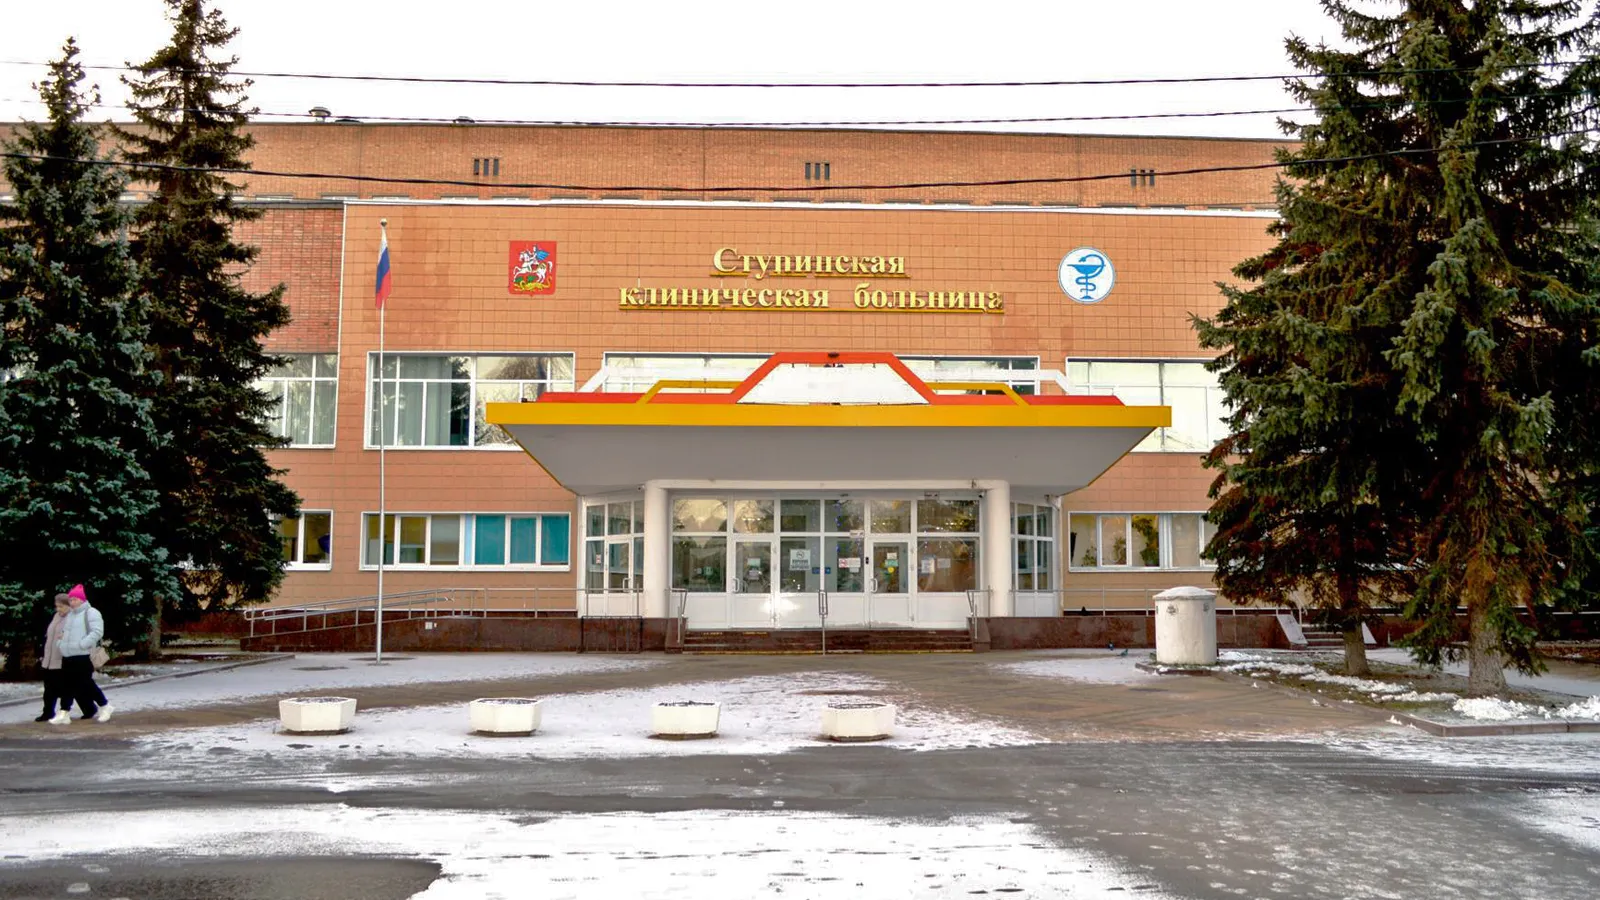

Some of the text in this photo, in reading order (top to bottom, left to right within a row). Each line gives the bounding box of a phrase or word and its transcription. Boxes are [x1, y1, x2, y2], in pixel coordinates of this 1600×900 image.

[712, 247, 905, 280] Ступинская
[619, 281, 1004, 313] клиническая больница
